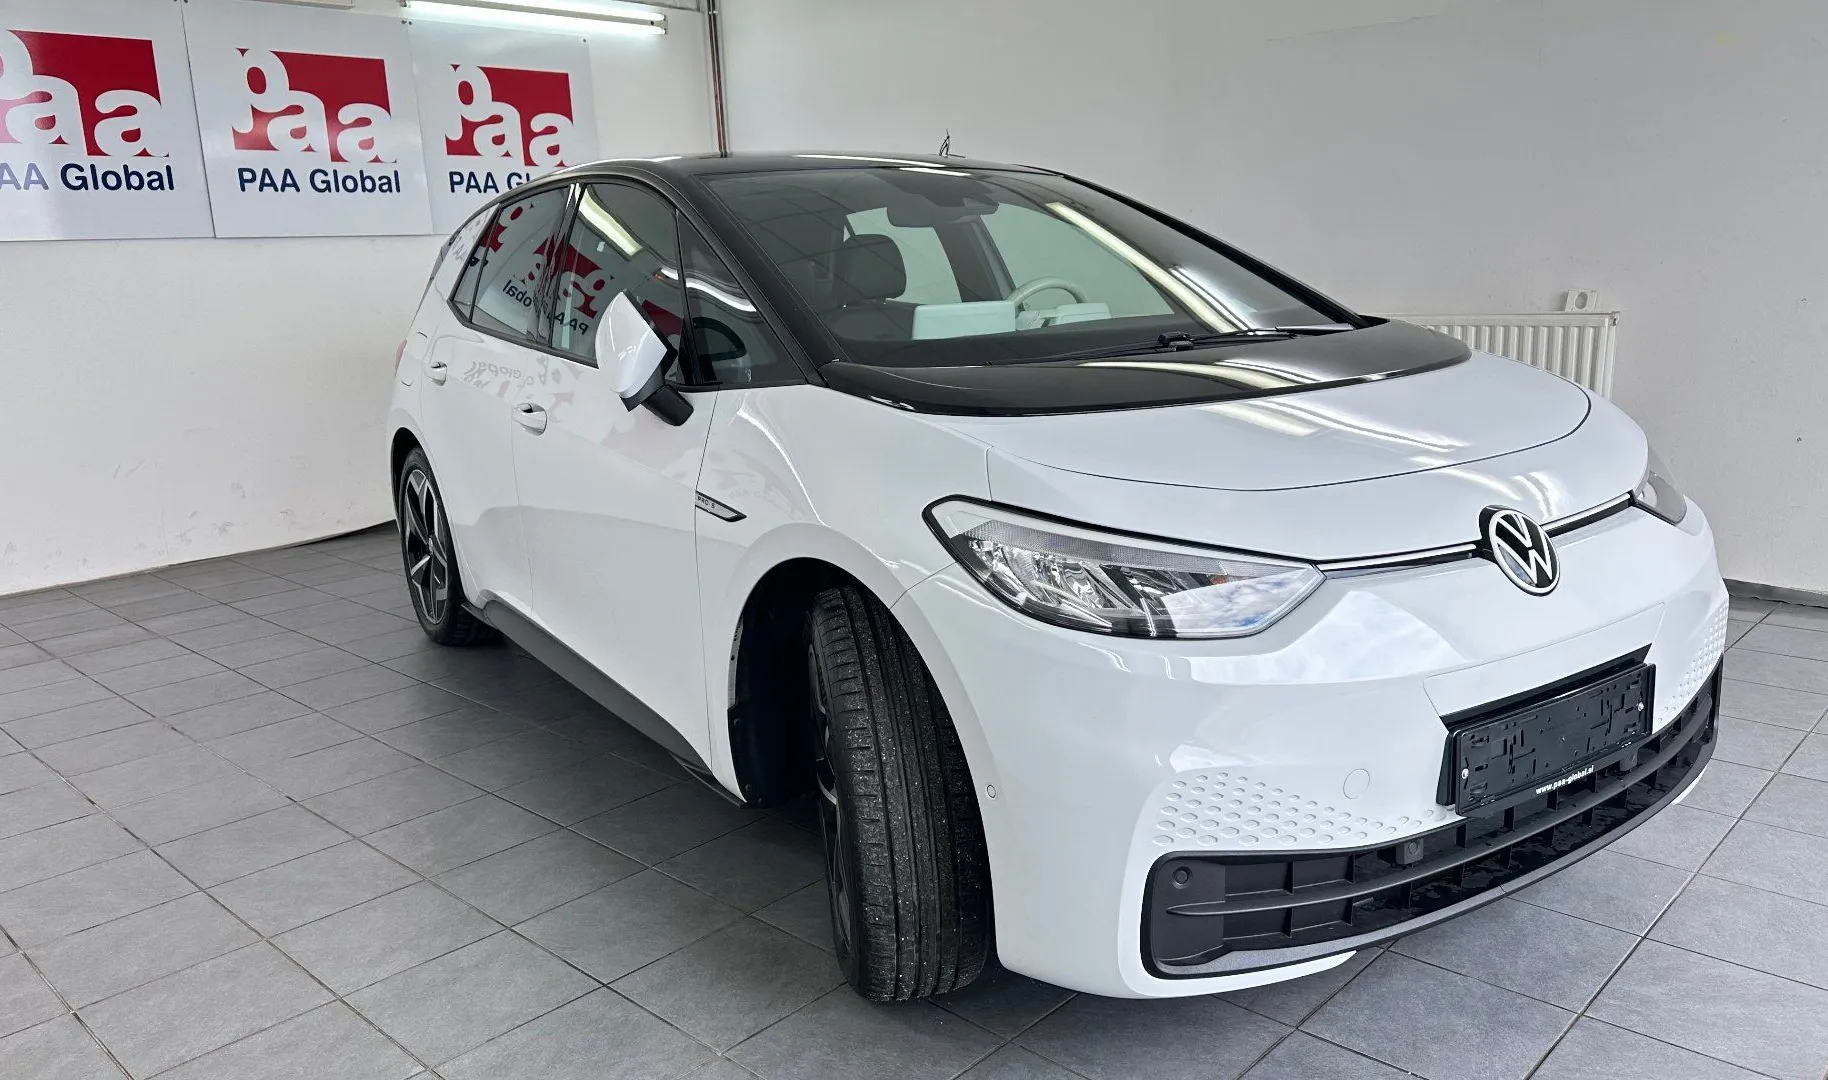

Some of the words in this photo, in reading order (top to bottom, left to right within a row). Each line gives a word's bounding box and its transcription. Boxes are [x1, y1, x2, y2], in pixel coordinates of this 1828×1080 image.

[0, 162, 49, 190] AA
[60, 163, 175, 191] Global
[237, 167, 301, 193] PAA
[309, 168, 400, 193] Global
[449, 171, 500, 194] PAA
[1535, 765, 1594, 794] www.paa-global.si
